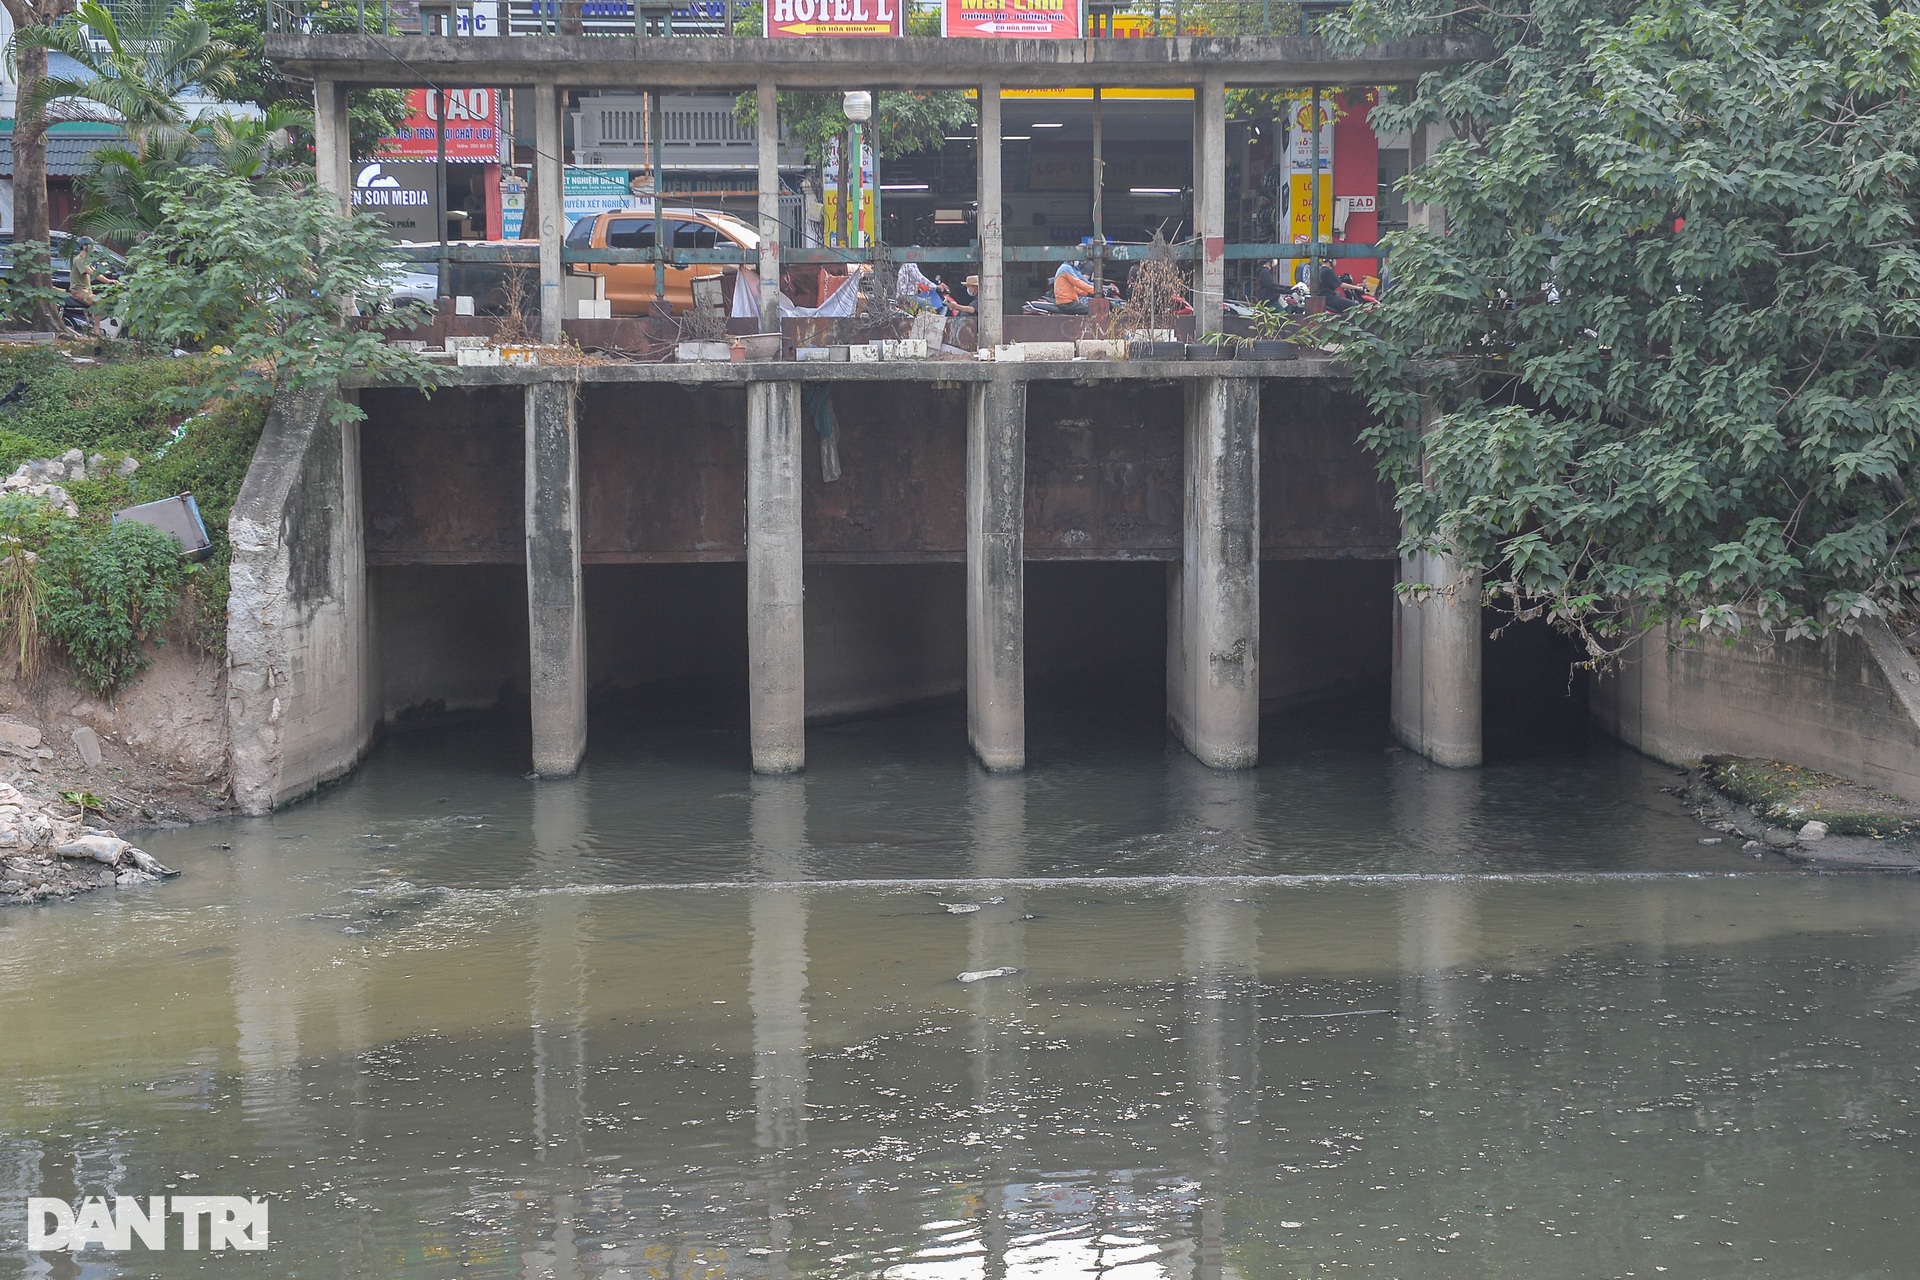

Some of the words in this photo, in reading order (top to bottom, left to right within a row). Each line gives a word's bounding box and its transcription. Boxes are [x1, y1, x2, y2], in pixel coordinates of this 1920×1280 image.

[416, 125, 436, 139] TRÊN
[445, 127, 454, 142] ỌI
[455, 124, 474, 140] CHẤT
[475, 126, 493, 142] LIỆU
[365, 190, 389, 206] SON
[391, 190, 429, 206] MEDIA
[1349, 198, 1373, 207] EAD
